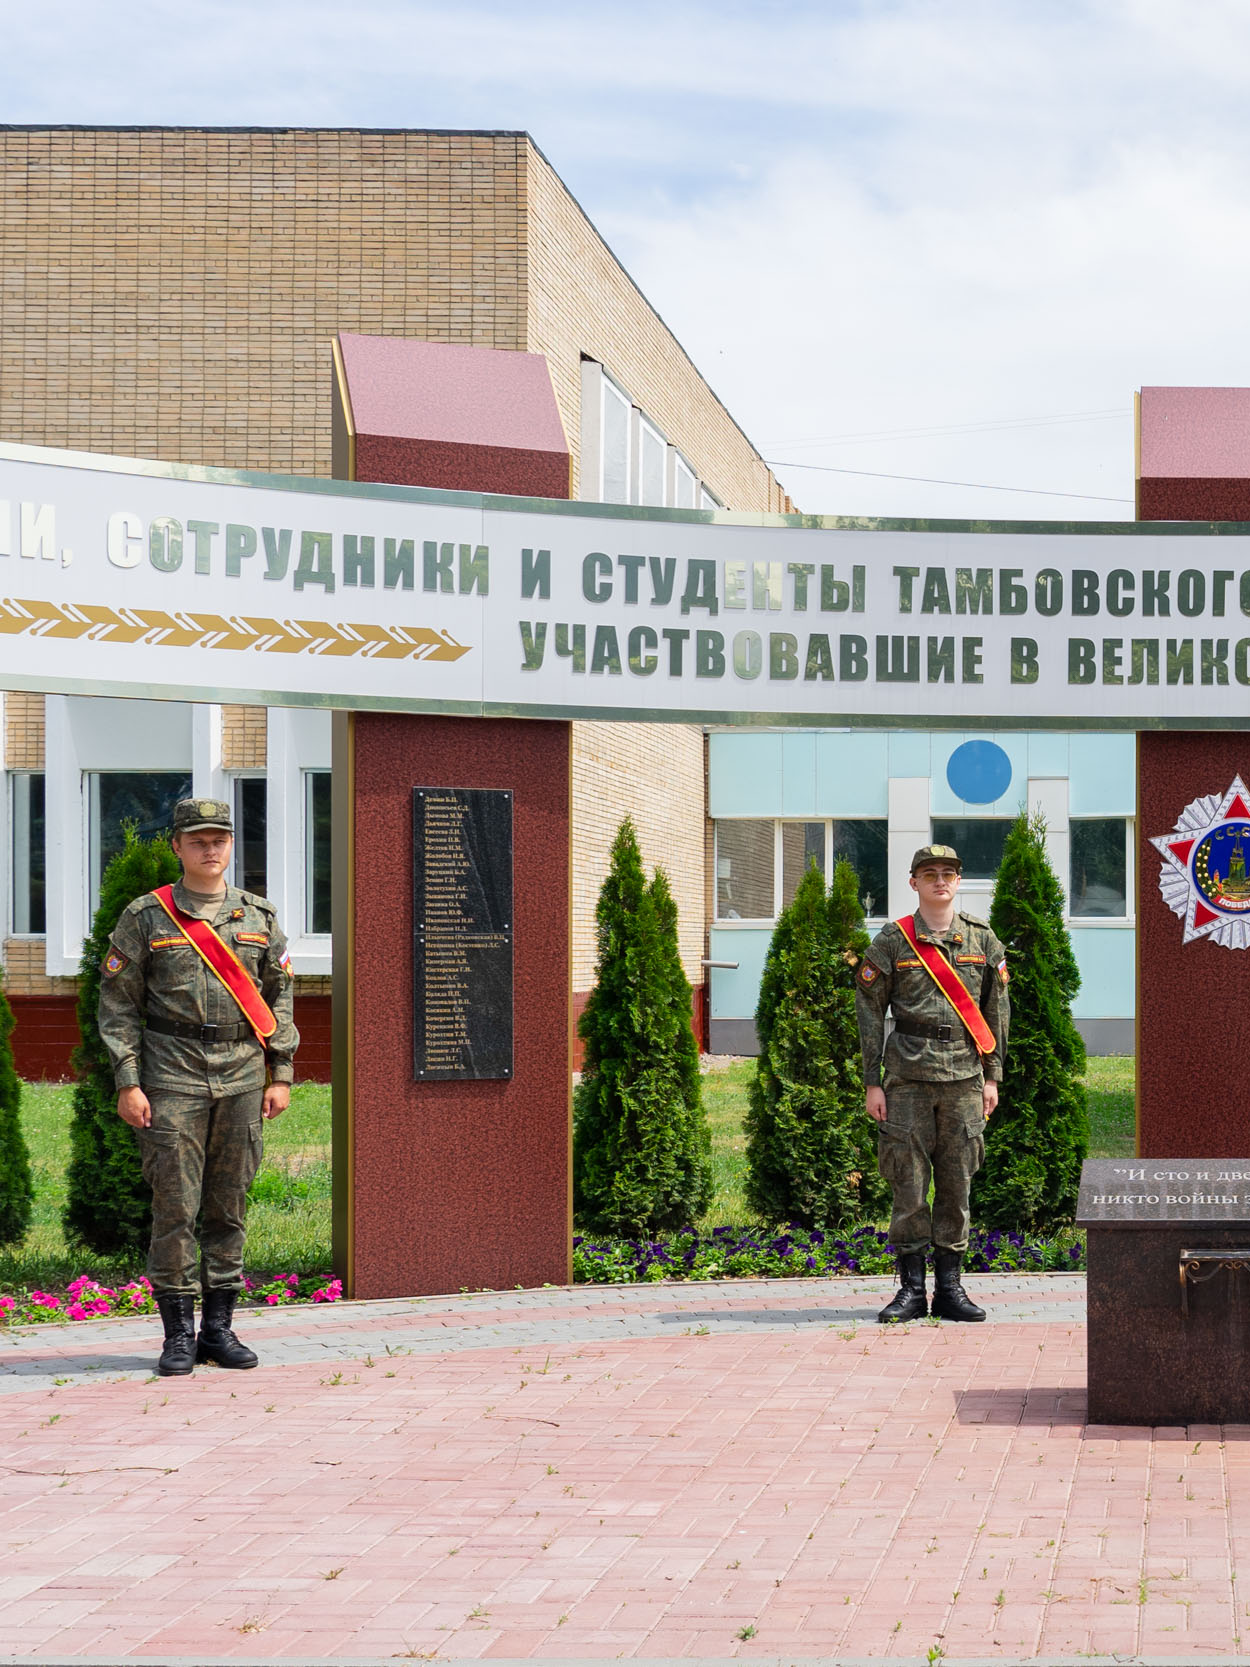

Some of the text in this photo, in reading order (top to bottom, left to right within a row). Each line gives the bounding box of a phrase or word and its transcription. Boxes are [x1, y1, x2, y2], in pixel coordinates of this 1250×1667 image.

[0, 500, 73, 569] И,
[107, 511, 490, 597] СОТРУДНИКИ
[520, 549, 551, 600] И
[582, 552, 867, 616] СТУДЕНТЫ
[520, 621, 984, 685] УЧАСТВОВАВШИЕ
[1010, 636, 1040, 685] В
[1153, 1171, 1189, 1181] сто
[1196, 1171, 1209, 1181] и
[1092, 1195, 1159, 1204] никто
[1166, 1192, 1239, 1204] войны
